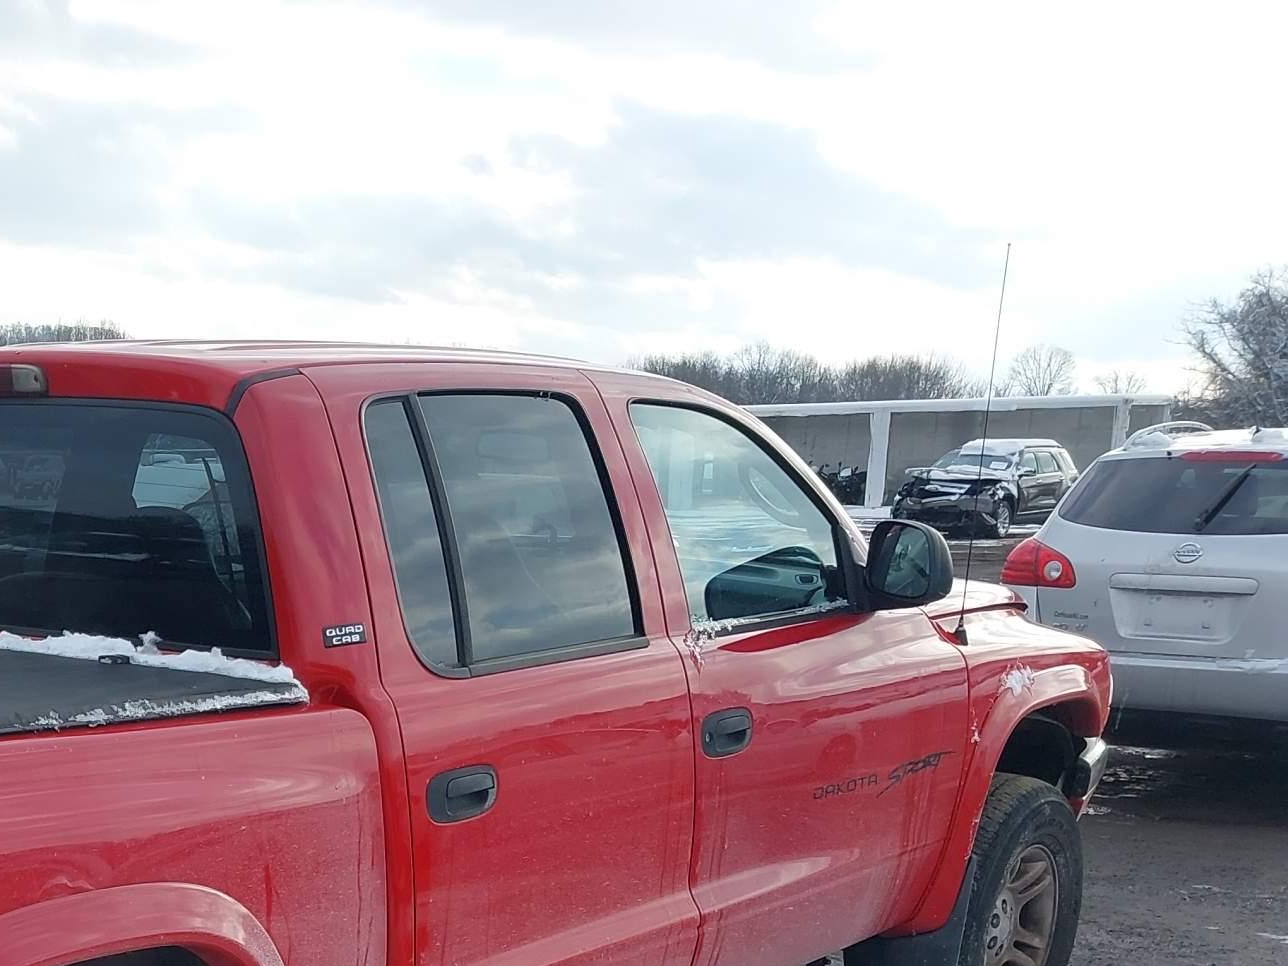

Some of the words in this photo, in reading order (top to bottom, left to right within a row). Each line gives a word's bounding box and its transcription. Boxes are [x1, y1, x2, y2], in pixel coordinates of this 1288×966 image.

[326, 625, 363, 636] QUAD
[333, 634, 360, 645] CAB
[813, 774, 878, 800] DAKOTA
[876, 751, 956, 799] SPORT
